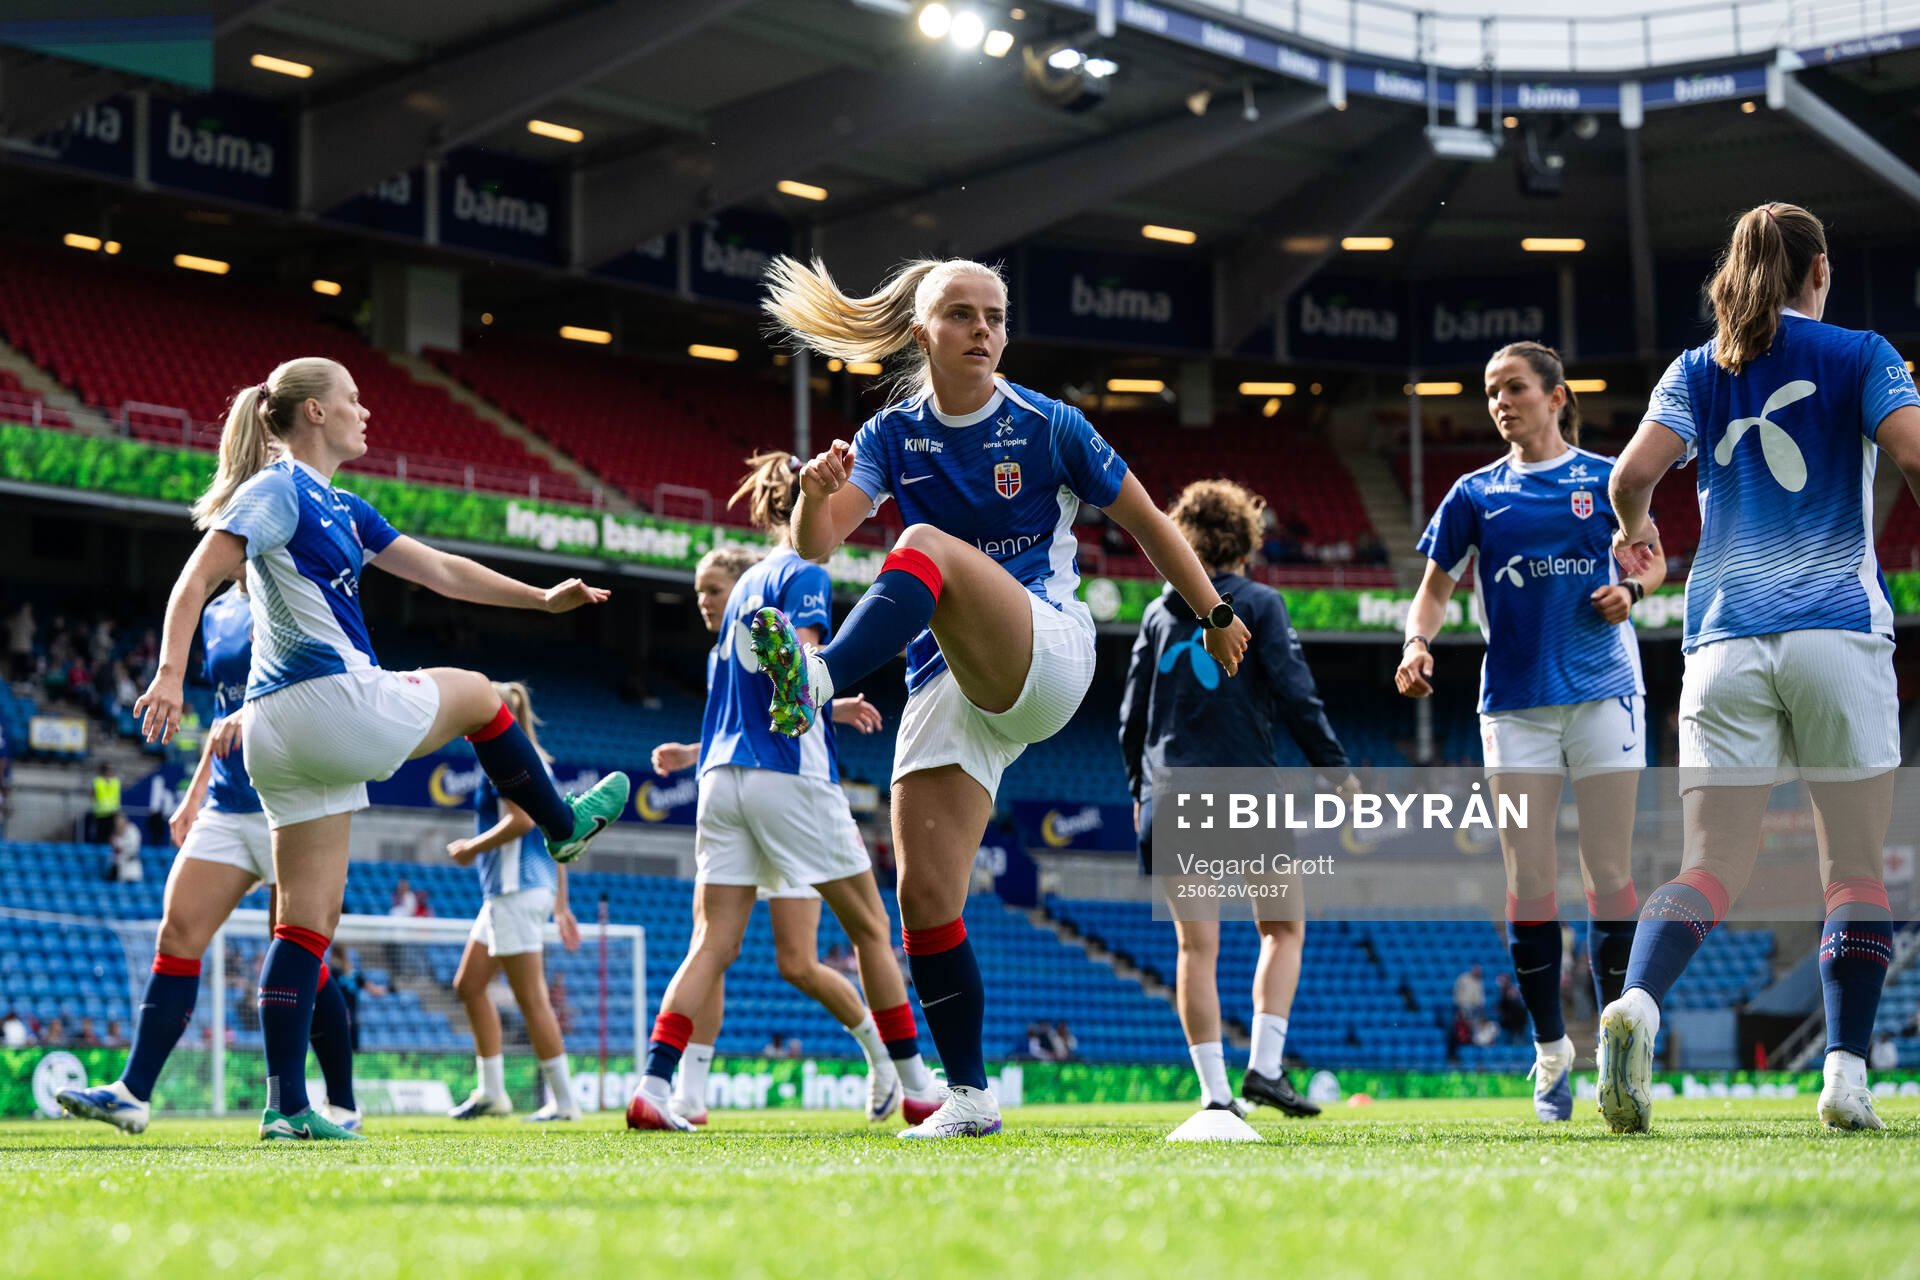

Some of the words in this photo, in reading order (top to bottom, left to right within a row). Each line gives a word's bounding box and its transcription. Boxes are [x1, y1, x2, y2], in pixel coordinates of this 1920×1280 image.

[904, 438, 930, 452] KIWI
[983, 440, 1002, 450] Norsk
[1002, 438, 1028, 448] Tipping
[1528, 554, 1598, 579] telenor
